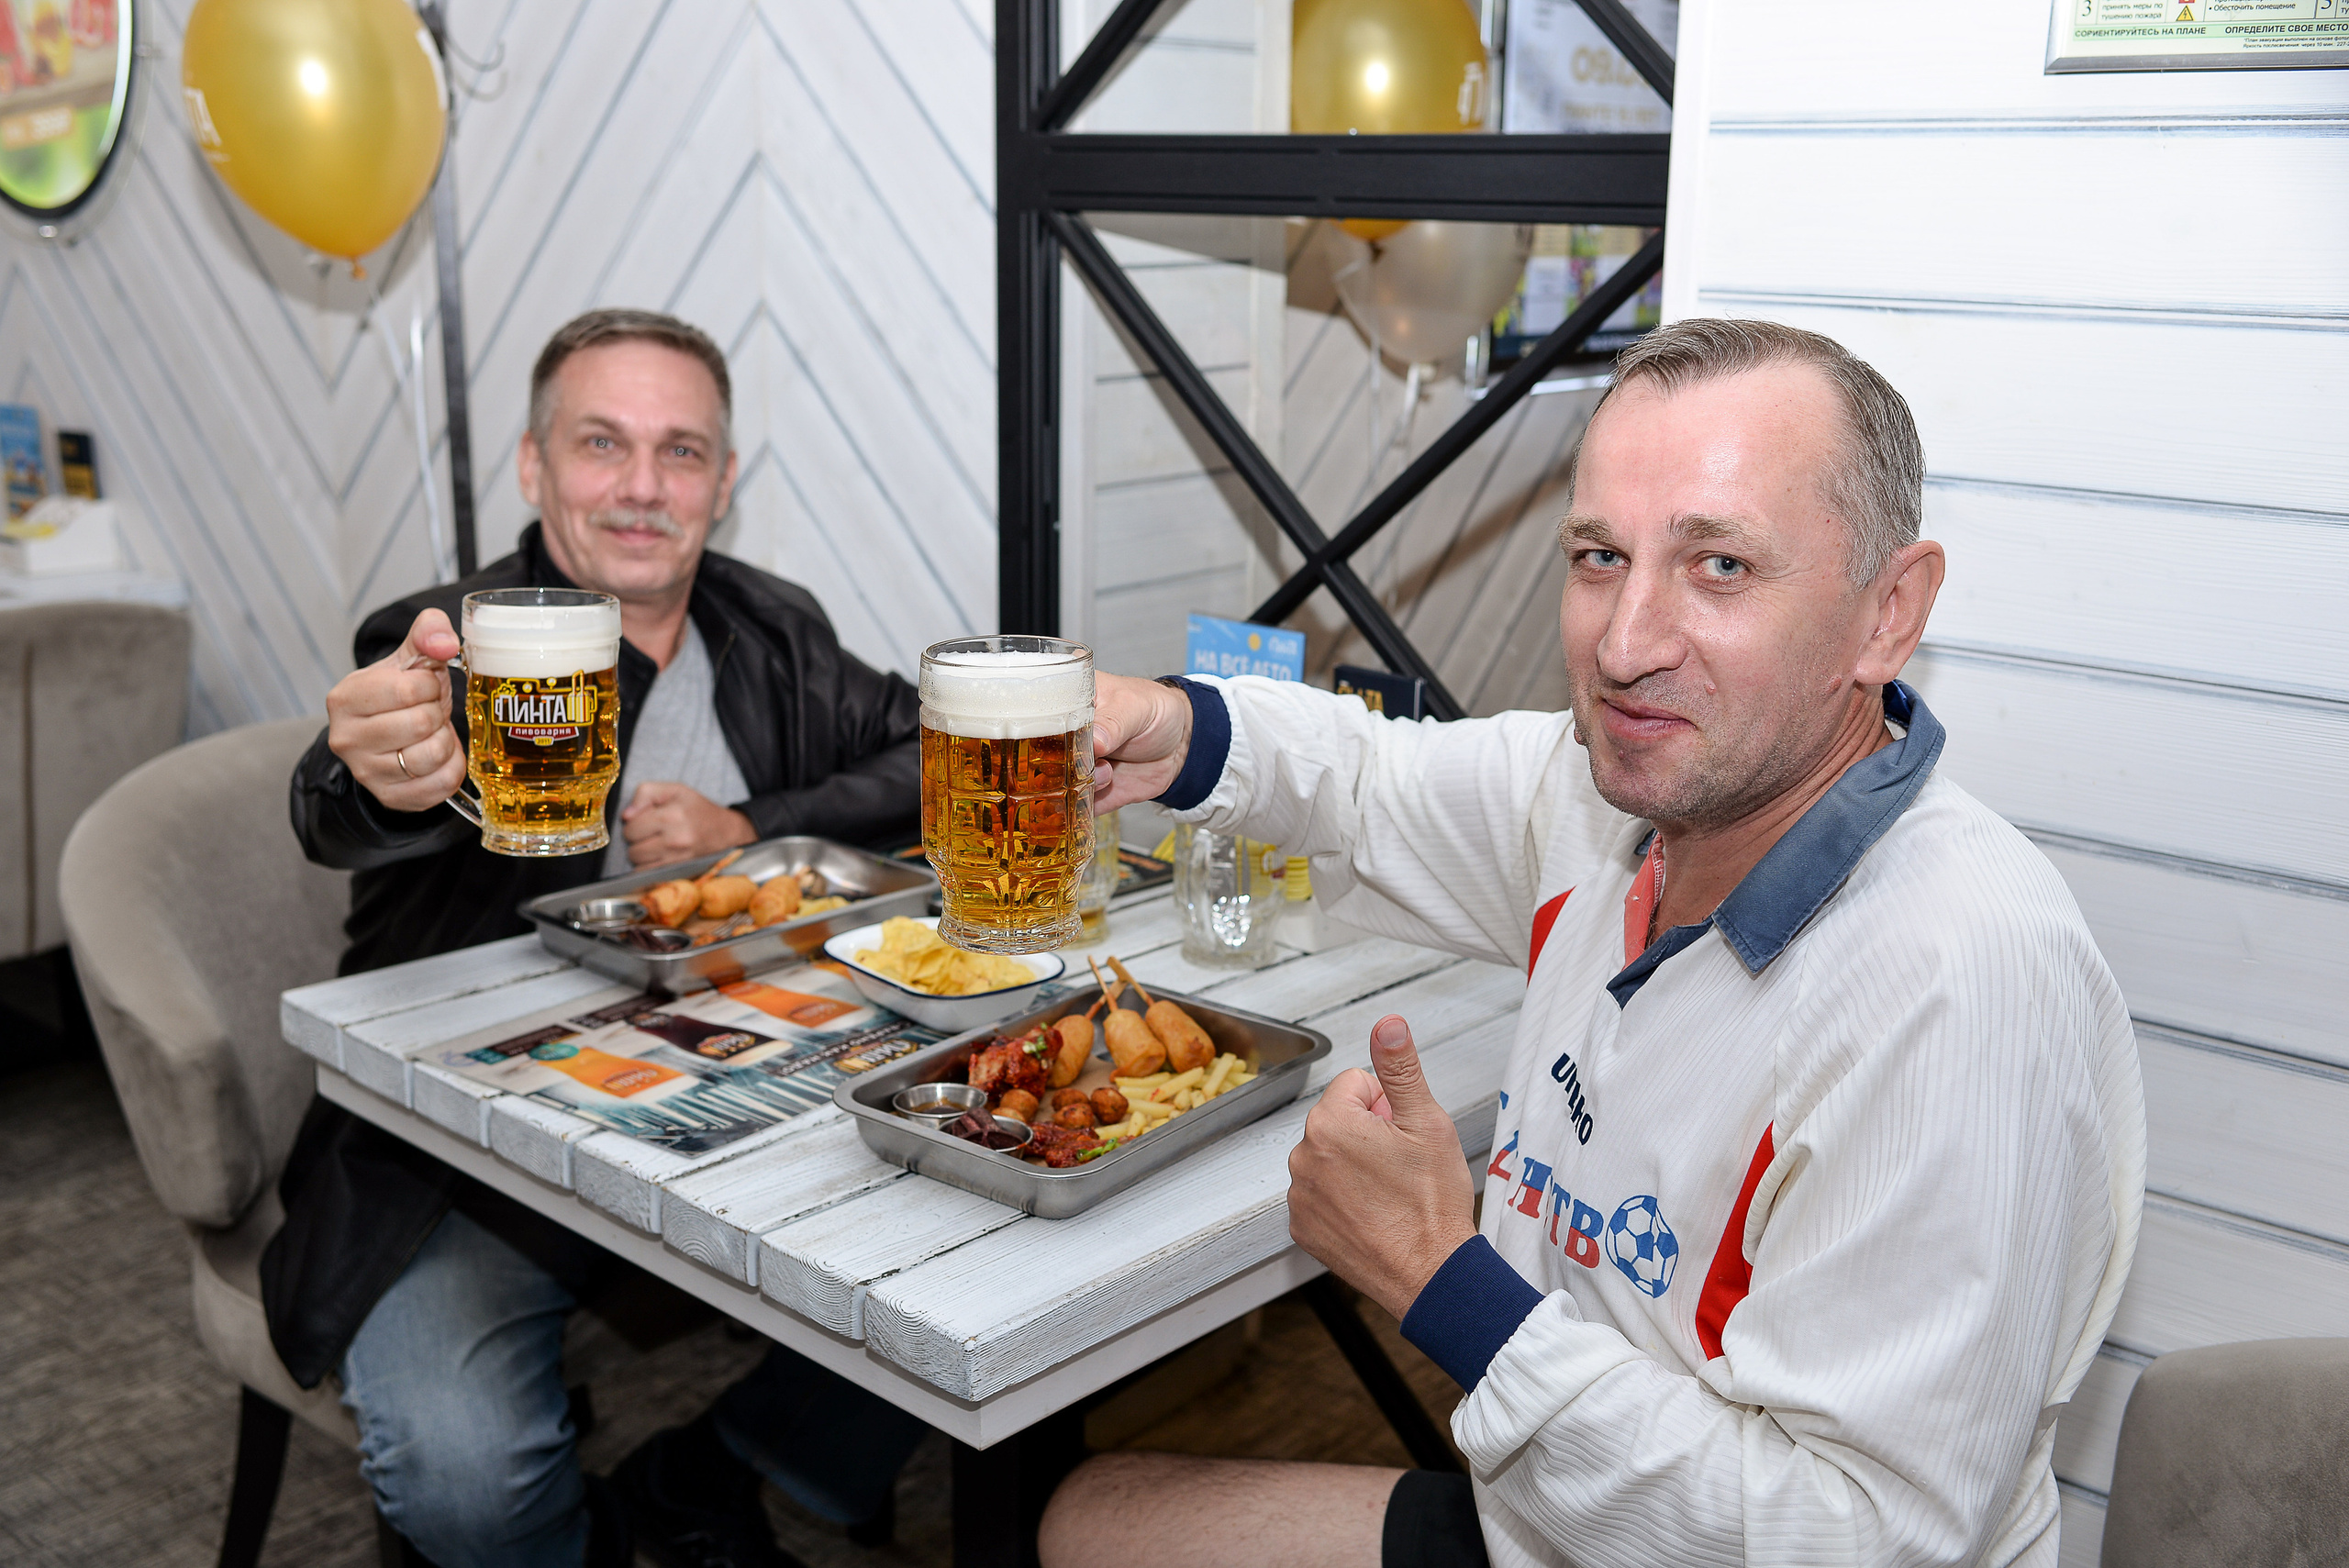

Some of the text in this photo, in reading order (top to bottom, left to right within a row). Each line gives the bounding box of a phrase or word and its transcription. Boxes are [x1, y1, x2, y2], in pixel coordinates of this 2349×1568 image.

[2081, 0, 2092, 17] 3
[2075, 27, 2207, 38] СОРИЕНТИРУЙТЕСЬ НА ПЛАНЕ
[2224, 25, 2286, 35] ОПРЕДЕЛИТЕ
[2288, 24, 2314, 32] СВОЕ
[1195, 649, 1218, 673] НА
[1251, 659, 1293, 681] ЛЕТО
[495, 695, 567, 724] ПИНТА
[515, 728, 572, 736] пивоварня
